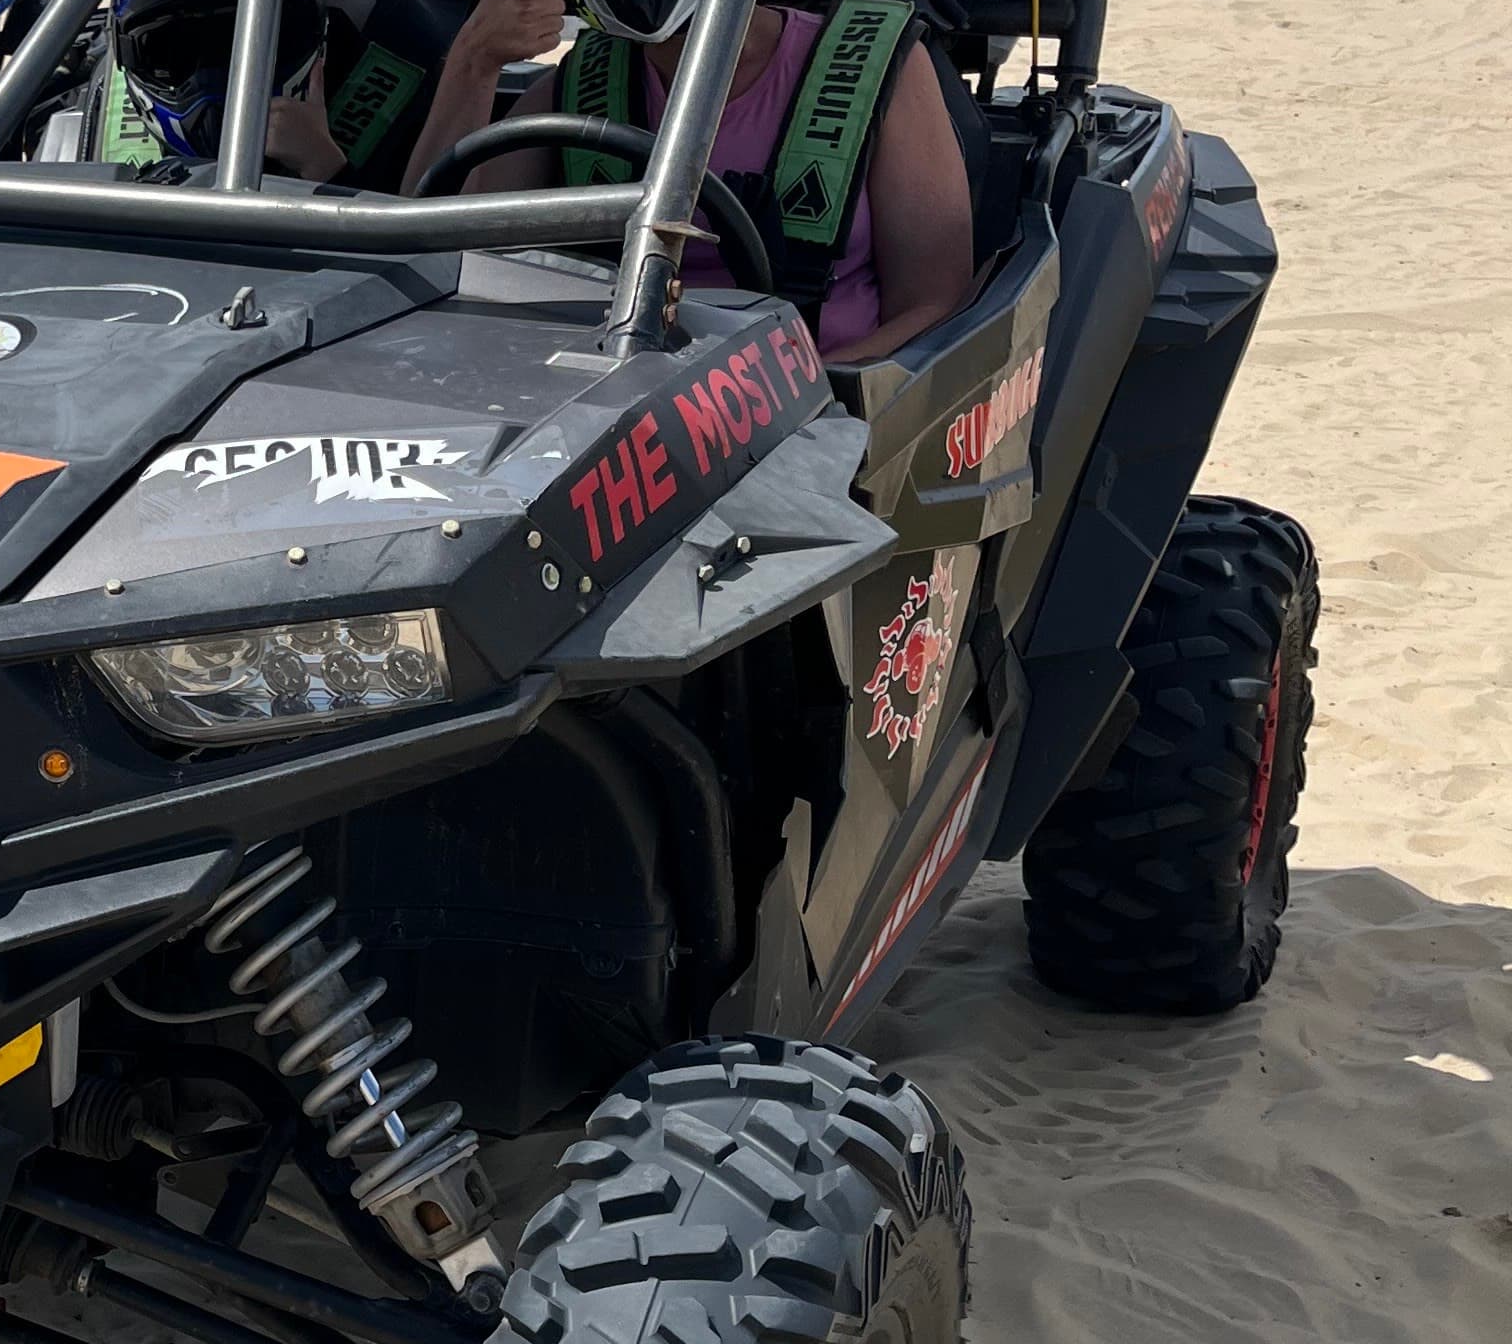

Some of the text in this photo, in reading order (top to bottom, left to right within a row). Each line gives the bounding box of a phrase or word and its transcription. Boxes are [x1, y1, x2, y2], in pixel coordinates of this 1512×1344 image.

[331, 65, 401, 152] ASSA
[577, 32, 613, 119] ASSAU
[805, 9, 888, 149] ASSAULT
[569, 410, 678, 563] THE
[671, 341, 784, 478] MOST
